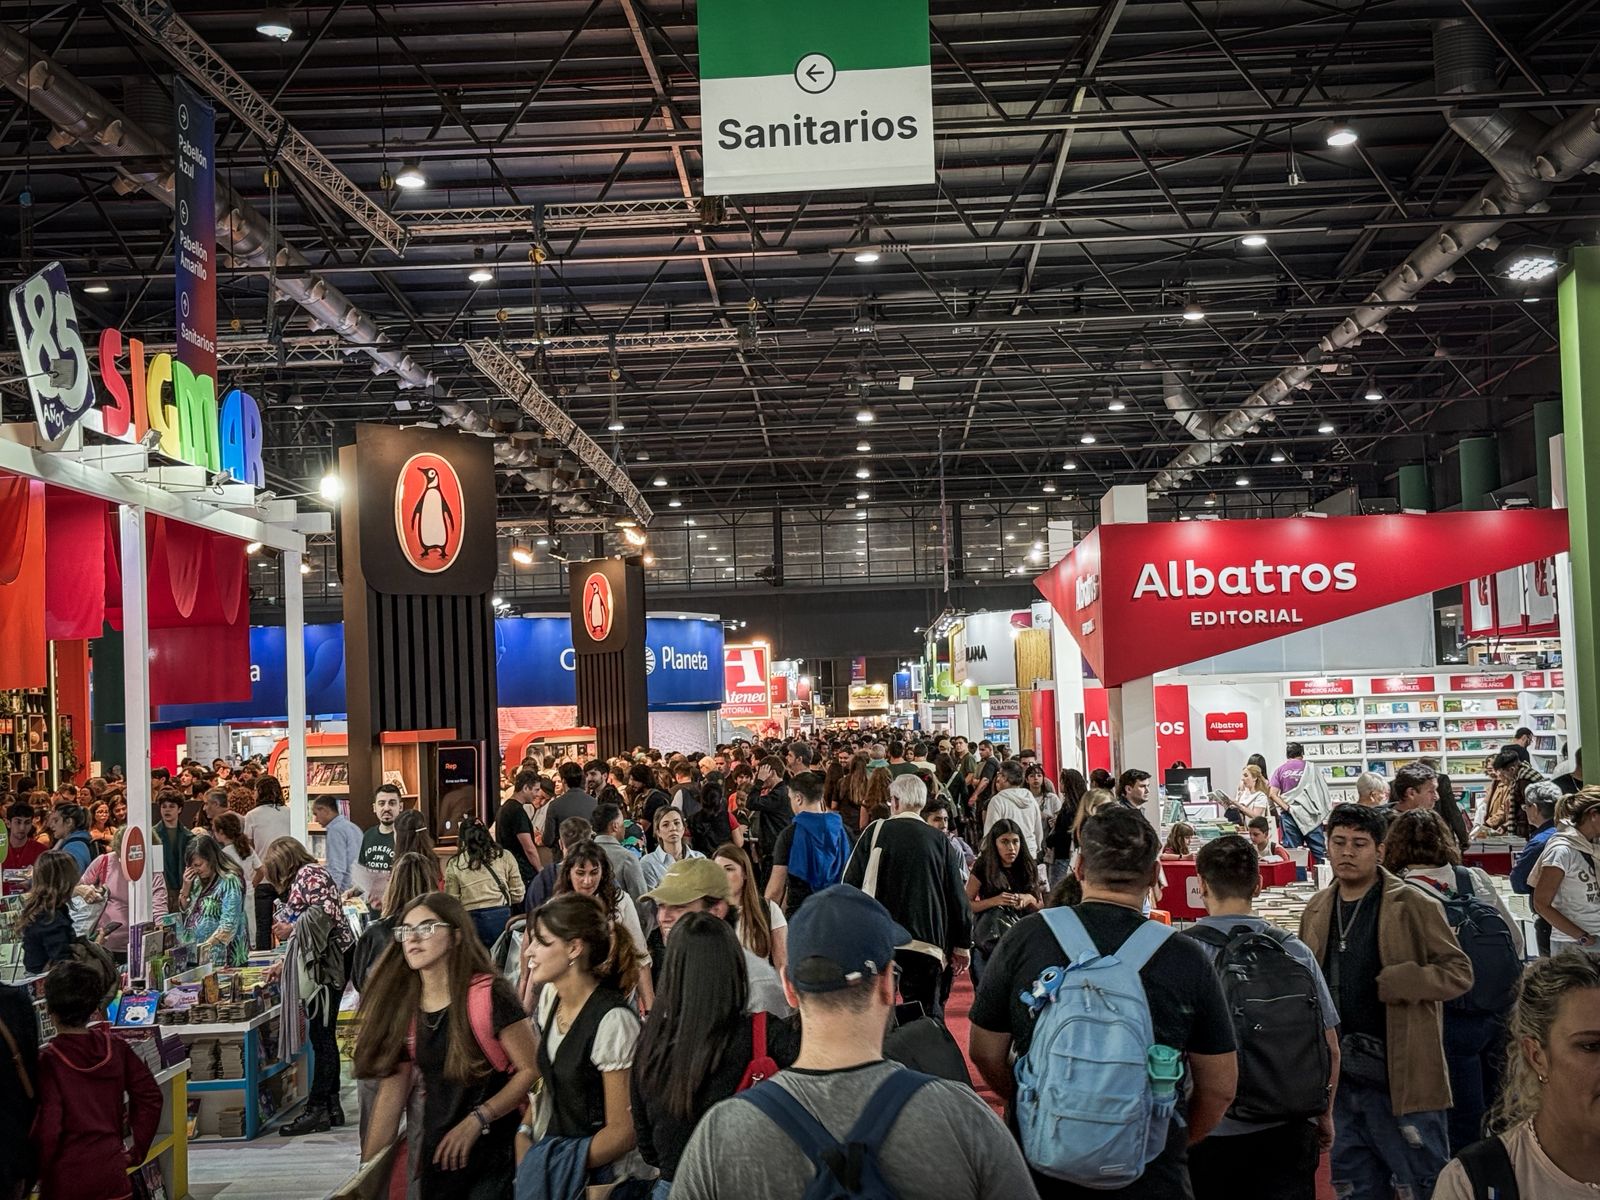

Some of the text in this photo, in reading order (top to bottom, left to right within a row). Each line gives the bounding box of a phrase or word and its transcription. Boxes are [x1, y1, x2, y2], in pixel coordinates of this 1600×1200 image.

[718, 110, 918, 150] Sanitarios
[178, 133, 207, 169] Pabellón
[179, 154, 195, 179] Azul
[180, 230, 208, 262] Pabellón
[180, 250, 207, 281] Amarillo
[24, 275, 88, 412] 85
[181, 322, 214, 354] Sanitarios
[42, 403, 65, 431] AÑOS
[1132, 559, 1358, 600] Albatros
[1190, 608, 1303, 626] EDITORIAL
[662, 646, 708, 671] Planeta
[1210, 721, 1244, 729] Albatros
